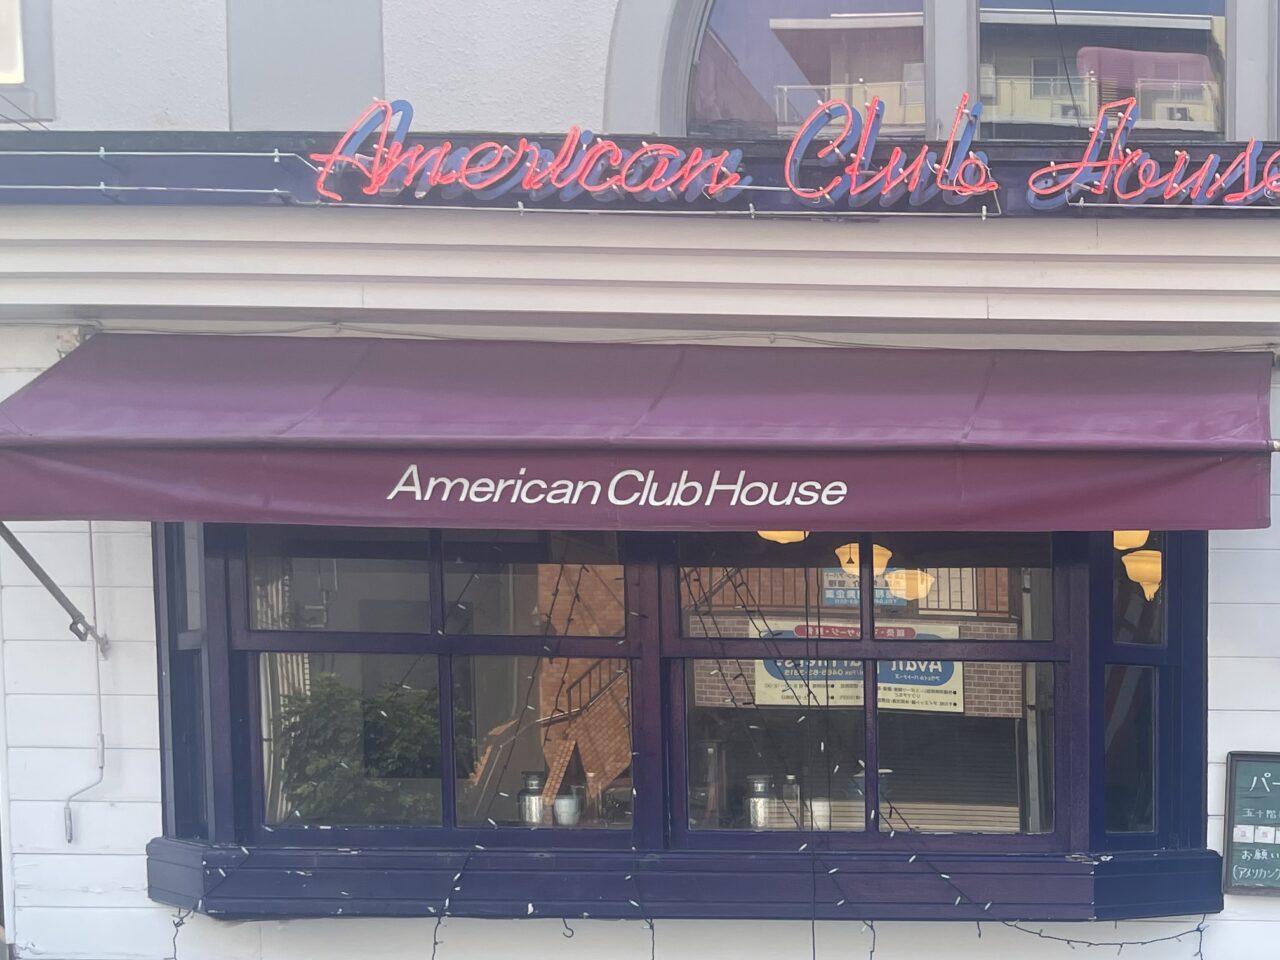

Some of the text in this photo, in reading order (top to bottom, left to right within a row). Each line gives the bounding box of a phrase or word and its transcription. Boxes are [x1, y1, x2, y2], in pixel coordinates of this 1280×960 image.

[310, 97, 742, 200] American
[785, 94, 998, 199] Club
[386, 464, 600, 505] American
